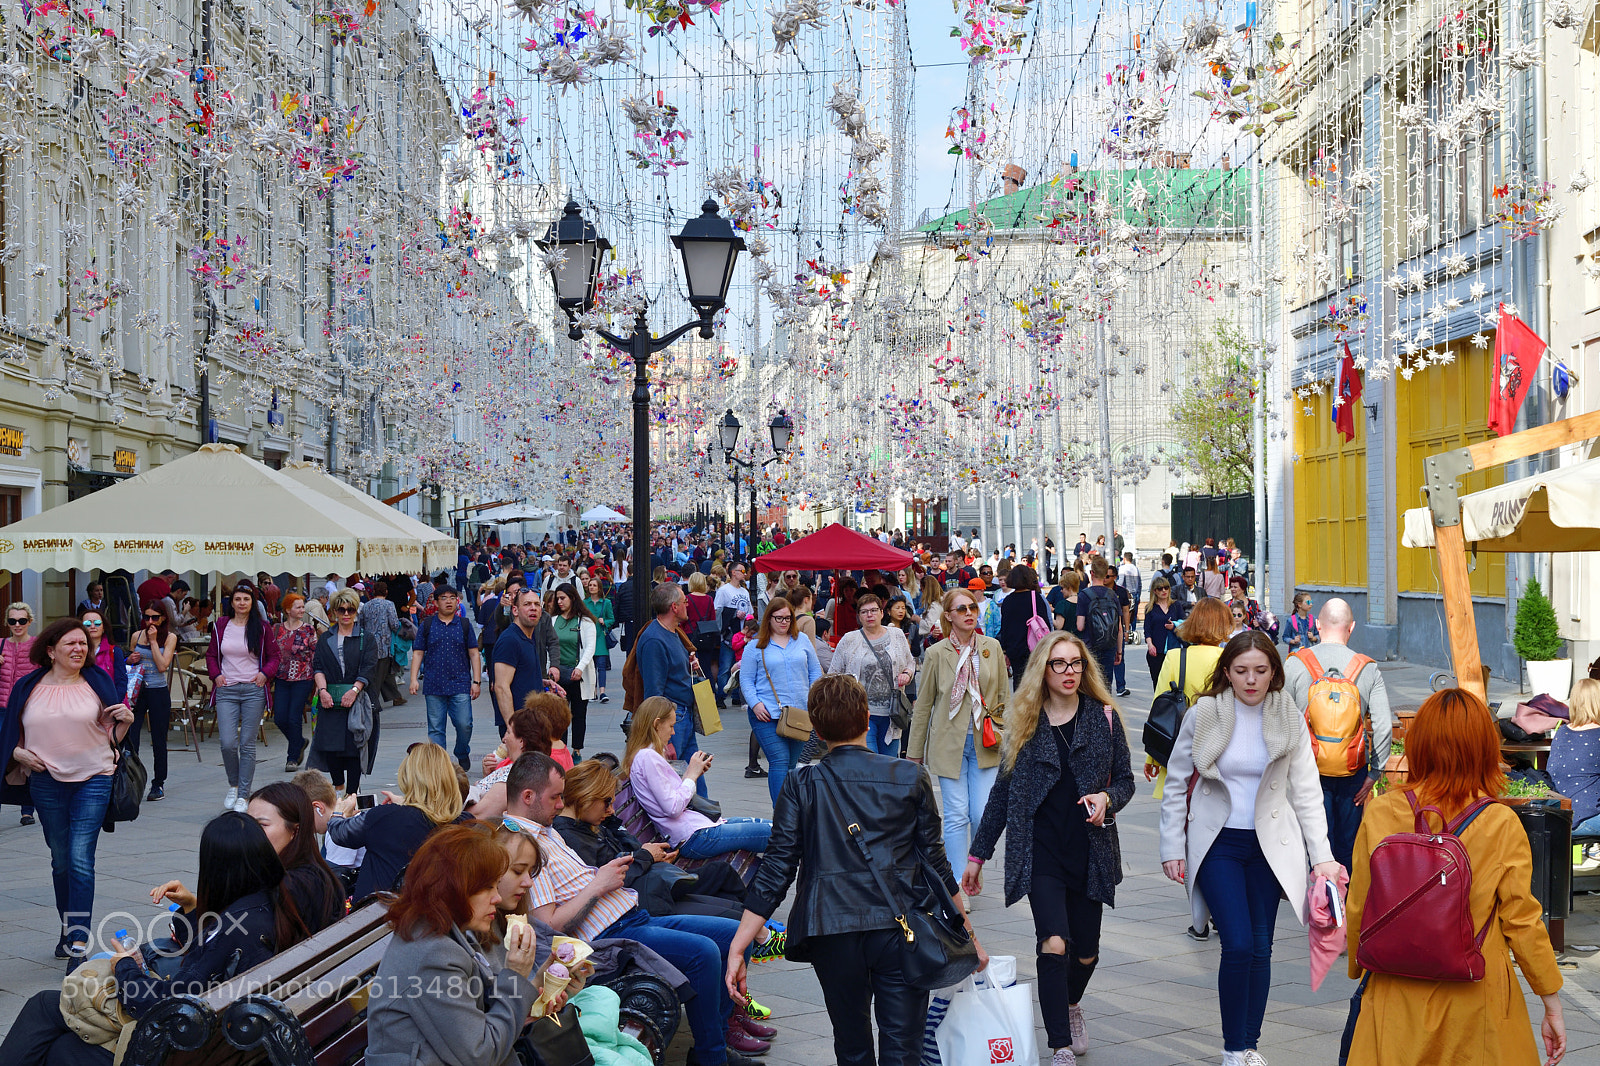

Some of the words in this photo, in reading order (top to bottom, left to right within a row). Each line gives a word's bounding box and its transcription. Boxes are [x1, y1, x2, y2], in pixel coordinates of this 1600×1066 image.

[23, 539, 73, 549] ВАРЕНИЧНАЯ
[113, 540, 164, 550] ВАРЕНИЧНАЯ
[204, 541, 254, 552] ВАРЕНИЧНАЯ
[294, 543, 344, 554] ВАРЕНИЧНАЯ
